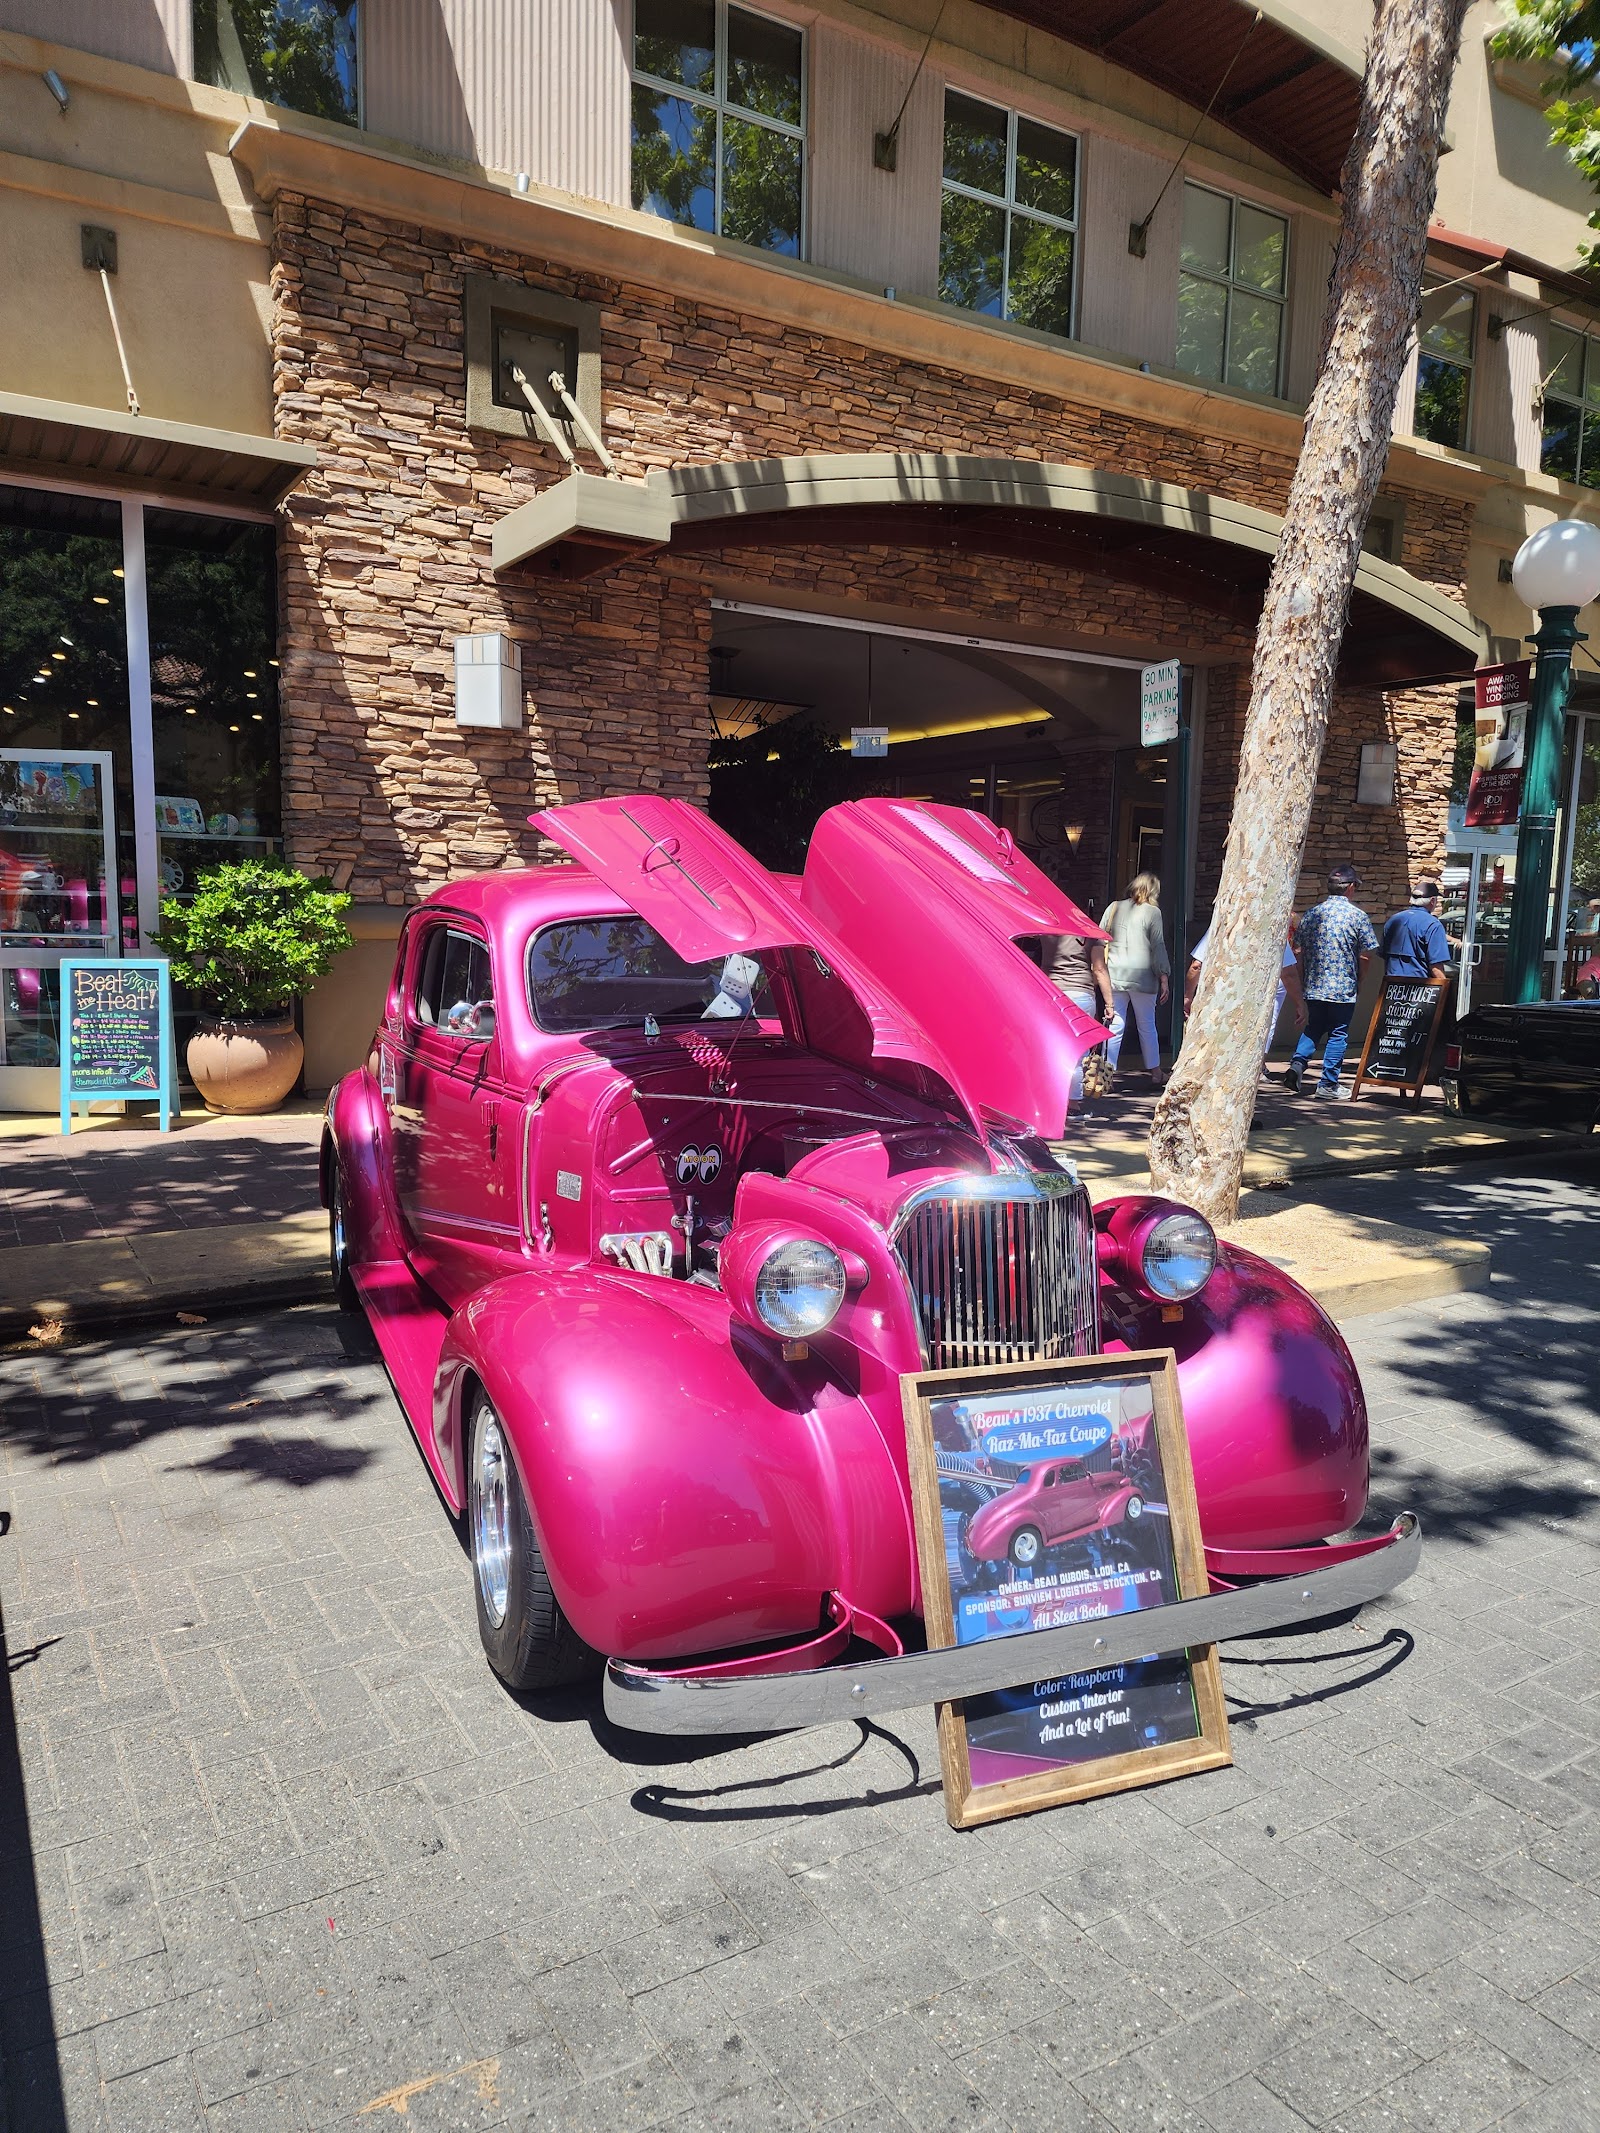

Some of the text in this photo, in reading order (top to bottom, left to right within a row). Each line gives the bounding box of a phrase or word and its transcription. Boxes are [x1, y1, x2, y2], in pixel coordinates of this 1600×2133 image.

[1145, 666, 1176, 687] 90 MIN.
[1485, 681, 1520, 694] WINNING
[1487, 673, 1518, 685] AWARD-
[1143, 686, 1177, 708] PARKING
[1485, 690, 1519, 703] LODGING
[74, 969, 128, 996] Beat
[97, 989, 156, 1011] Heat!
[1387, 1028, 1402, 1036] WINE
[684, 1155, 716, 1163] MOON
[973, 1398, 1112, 1429] Beau's 1937 Chevrolet
[986, 1425, 1107, 1453] Raz-Ma-Taz Coupe
[965, 1600, 1012, 1615] SPONSOR:
[1014, 1591, 1051, 1607] SUNVIEW
[1150, 1569, 1162, 1581] CA
[998, 1581, 1032, 1596] OWNER:
[1034, 1575, 1058, 1588] BEAU
[1117, 1561, 1130, 1574] CA
[1033, 1602, 1108, 1630] All Steel Body
[1033, 1667, 1124, 1697] Color: Raspberry
[1039, 1689, 1124, 1719] Custom Interior
[1039, 1706, 1131, 1744] And a Lot of Fun!
